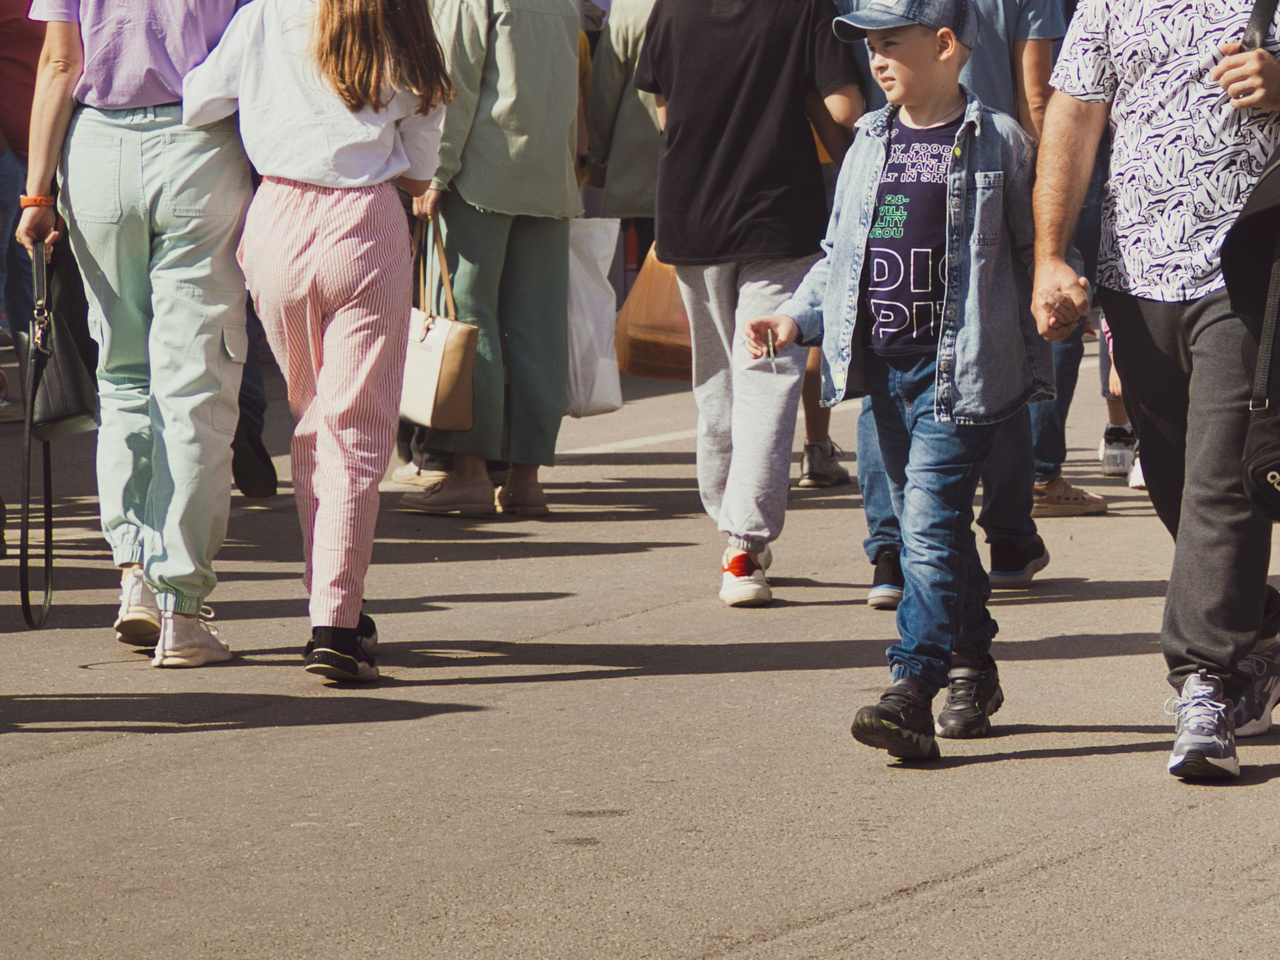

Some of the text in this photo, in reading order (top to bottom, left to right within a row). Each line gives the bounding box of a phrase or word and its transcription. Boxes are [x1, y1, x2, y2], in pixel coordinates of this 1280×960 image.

[909, 143, 953, 155] FOOD
[905, 162, 946, 174] LANE
[900, 172, 918, 183] IN
[869, 227, 904, 239] GOU
